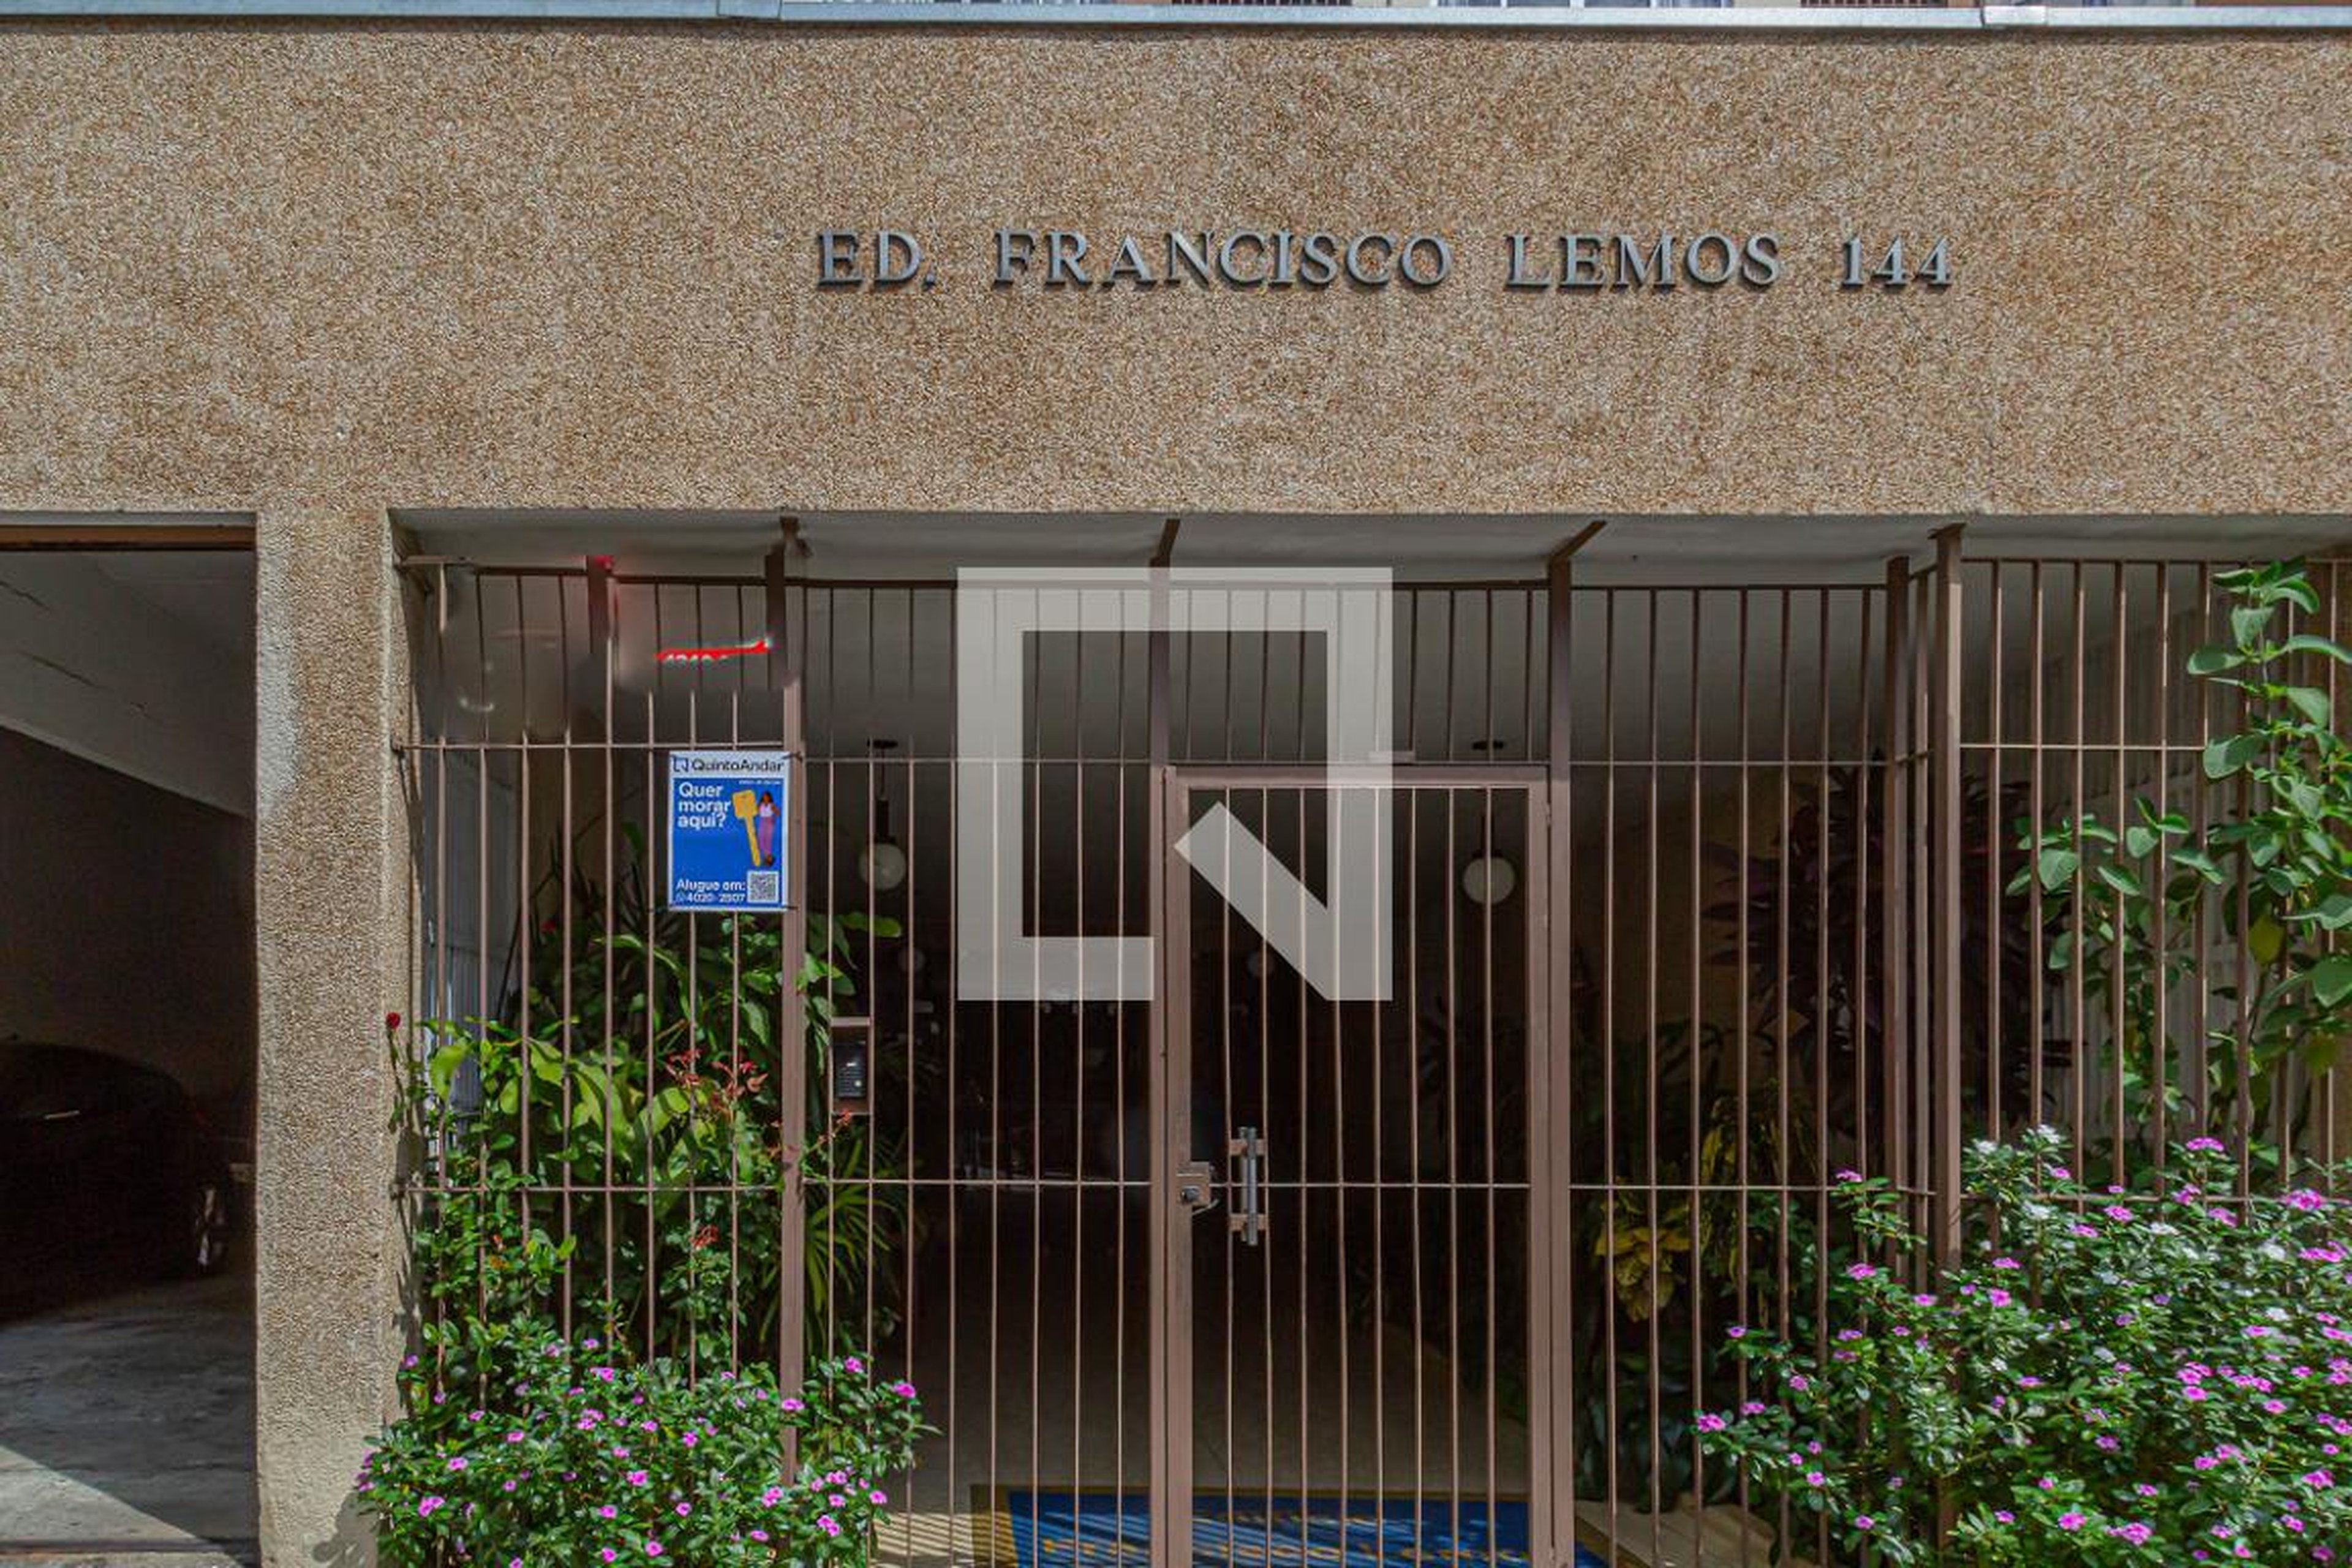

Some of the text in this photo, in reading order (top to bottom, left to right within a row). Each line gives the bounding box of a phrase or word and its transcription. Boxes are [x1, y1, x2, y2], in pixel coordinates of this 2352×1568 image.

[817, 229, 1952, 291] ED. FRANCISCO LEMOS 144
[692, 758, 785, 772] QuintoAndar
[678, 782, 724, 798] Quer
[678, 800, 731, 813] morar
[677, 813, 726, 830] aqui?
[676, 878, 746, 892] Alugue em:
